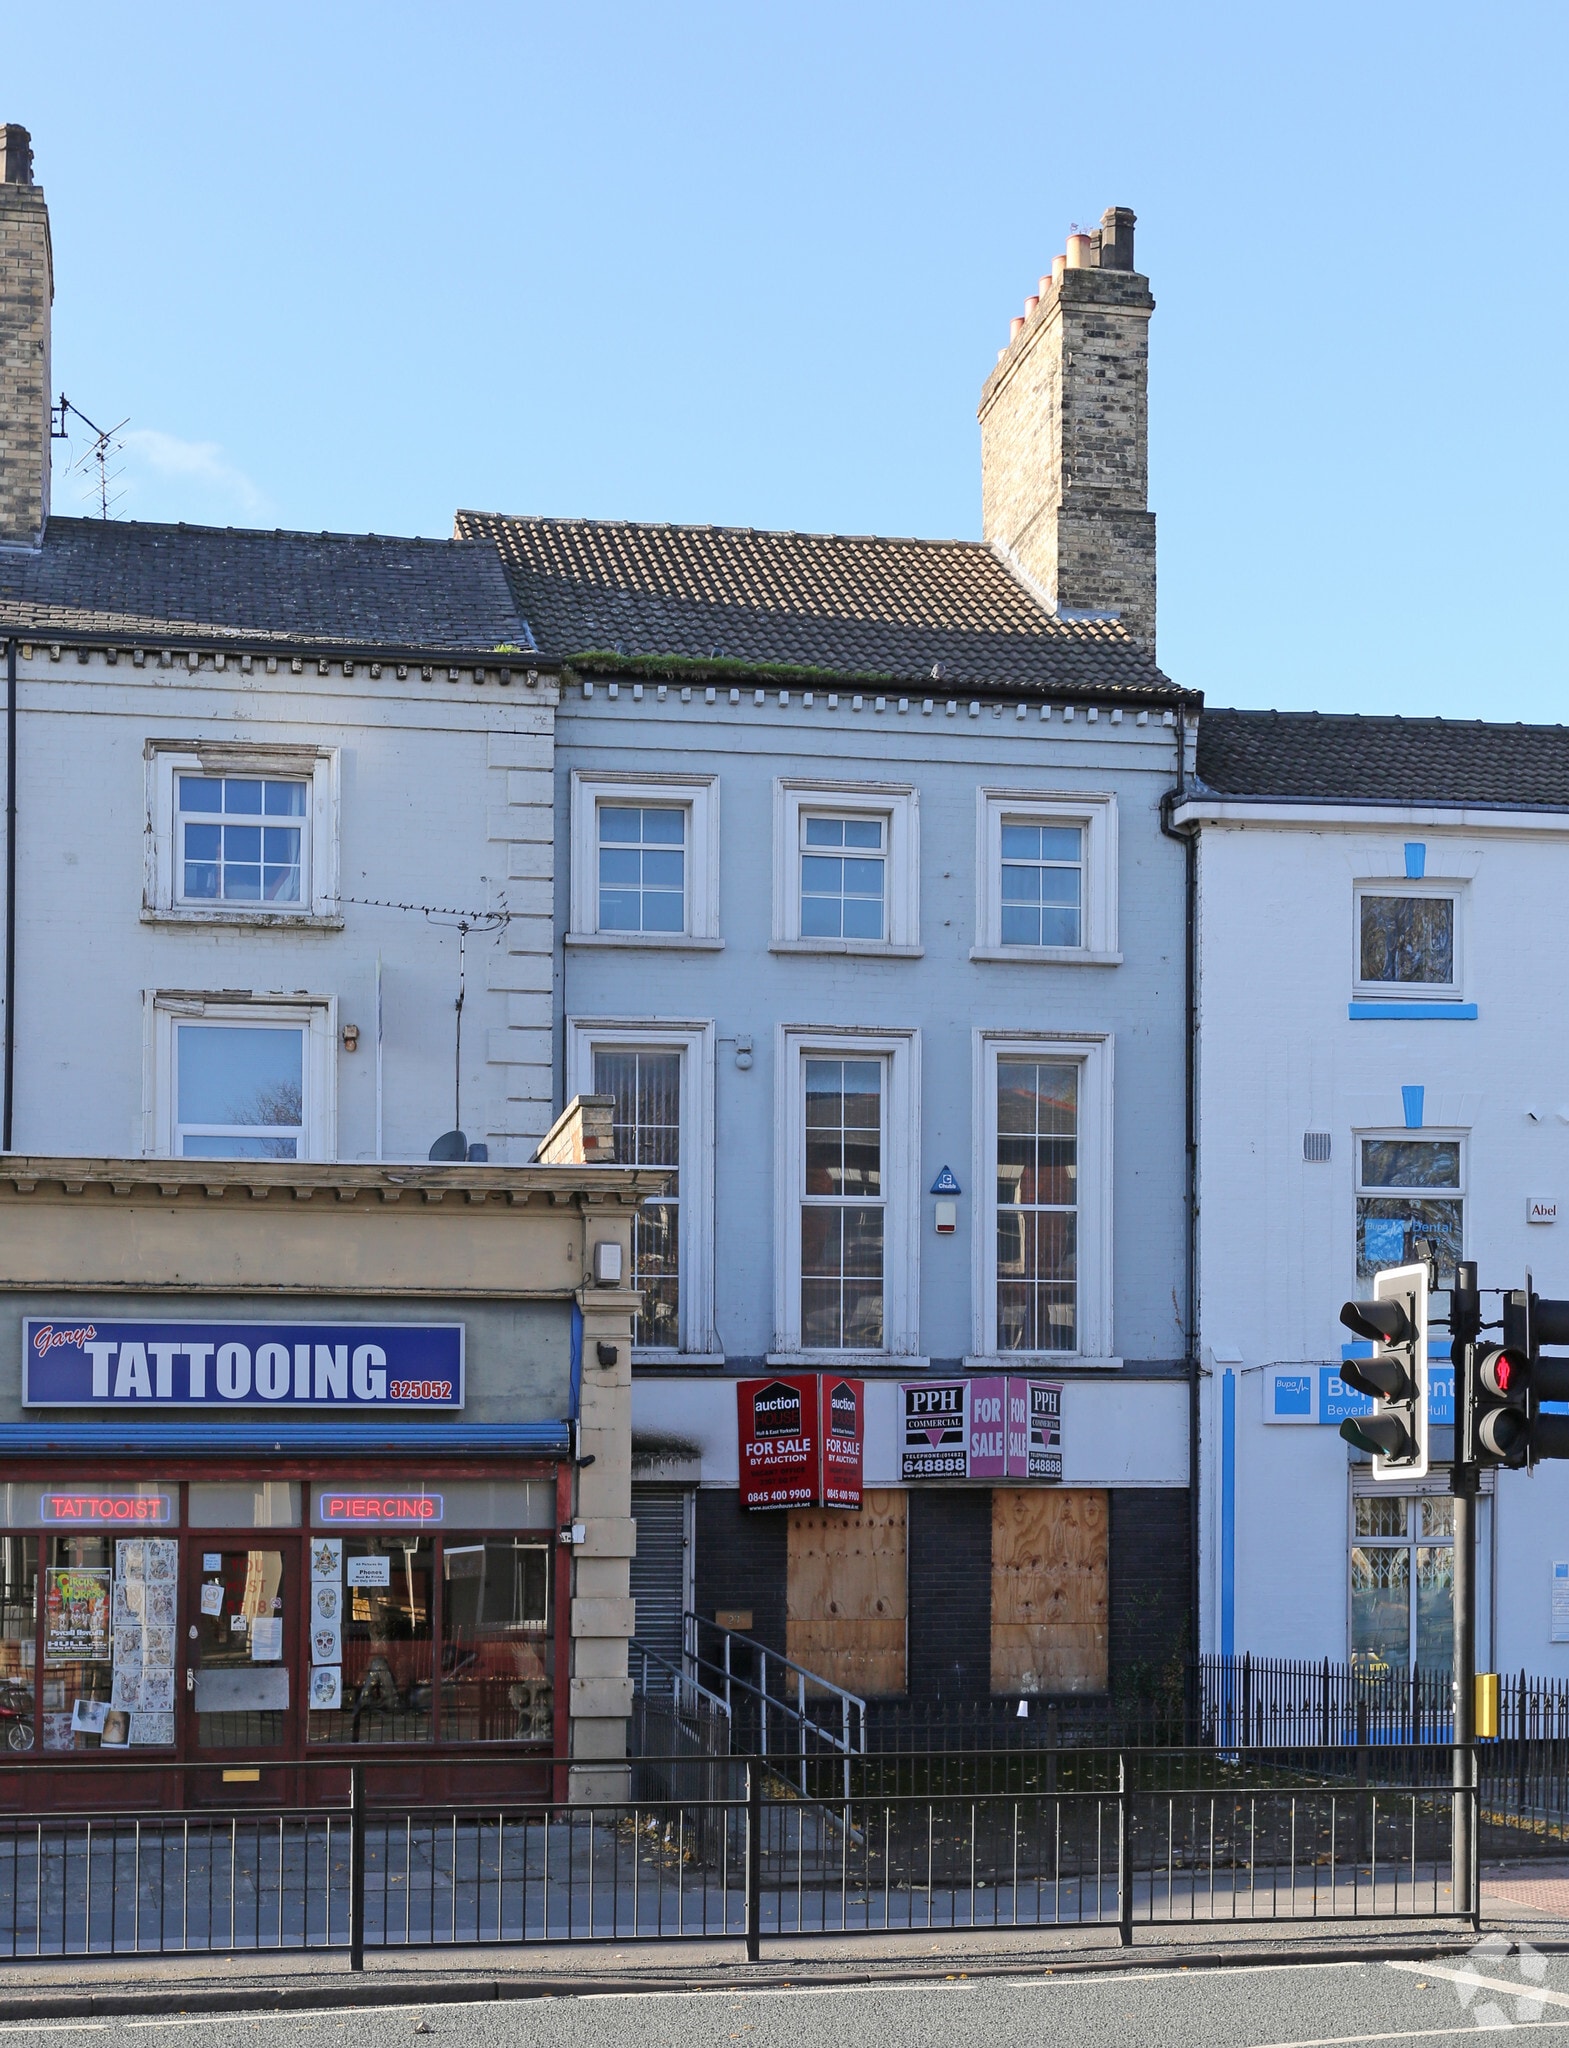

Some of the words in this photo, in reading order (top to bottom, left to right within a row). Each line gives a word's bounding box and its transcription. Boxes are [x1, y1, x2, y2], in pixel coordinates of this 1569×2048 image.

[1532, 1204, 1556, 1216] Abel
[1412, 1221, 1452, 1233] Dental
[33, 1324, 97, 1358] Garys
[84, 1341, 387, 1400] TATTOOING
[390, 1379, 452, 1400] 325052
[1276, 1379, 1297, 1389] Bupa
[755, 1396, 800, 1412] auction
[831, 1398, 856, 1412] auction
[911, 1389, 958, 1413] PPH
[1034, 1390, 1058, 1413] PPH
[756, 1410, 799, 1426] HOUSE
[974, 1398, 1001, 1424] FOR
[1010, 1398, 1026, 1424] FOR
[1327, 1404, 1373, 1416] Beverle
[908, 1418, 961, 1429] COMMERCIAL
[746, 1442, 773, 1456] FOR
[777, 1438, 811, 1454] SALE
[826, 1438, 841, 1452] FOR
[843, 1441, 860, 1455] SALE
[971, 1432, 1003, 1458] SALE
[1009, 1432, 1027, 1458] SALE
[750, 1457, 762, 1466] BY
[764, 1454, 807, 1464] AUCTION
[828, 1454, 836, 1462] BY
[836, 1455, 858, 1465] AUCTION
[903, 1458, 966, 1473] 648888
[1029, 1458, 1062, 1473] 648888
[747, 1492, 769, 1502] 0845
[771, 1490, 787, 1501] 400
[789, 1488, 811, 1499] 9900
[827, 1489, 839, 1499] 0845
[839, 1490, 848, 1500] 400
[848, 1491, 859, 1501] 9900
[51, 1498, 161, 1518] TATTOOIST
[329, 1499, 434, 1518] PIERCING
[252, 1600, 267, 1614] 18
